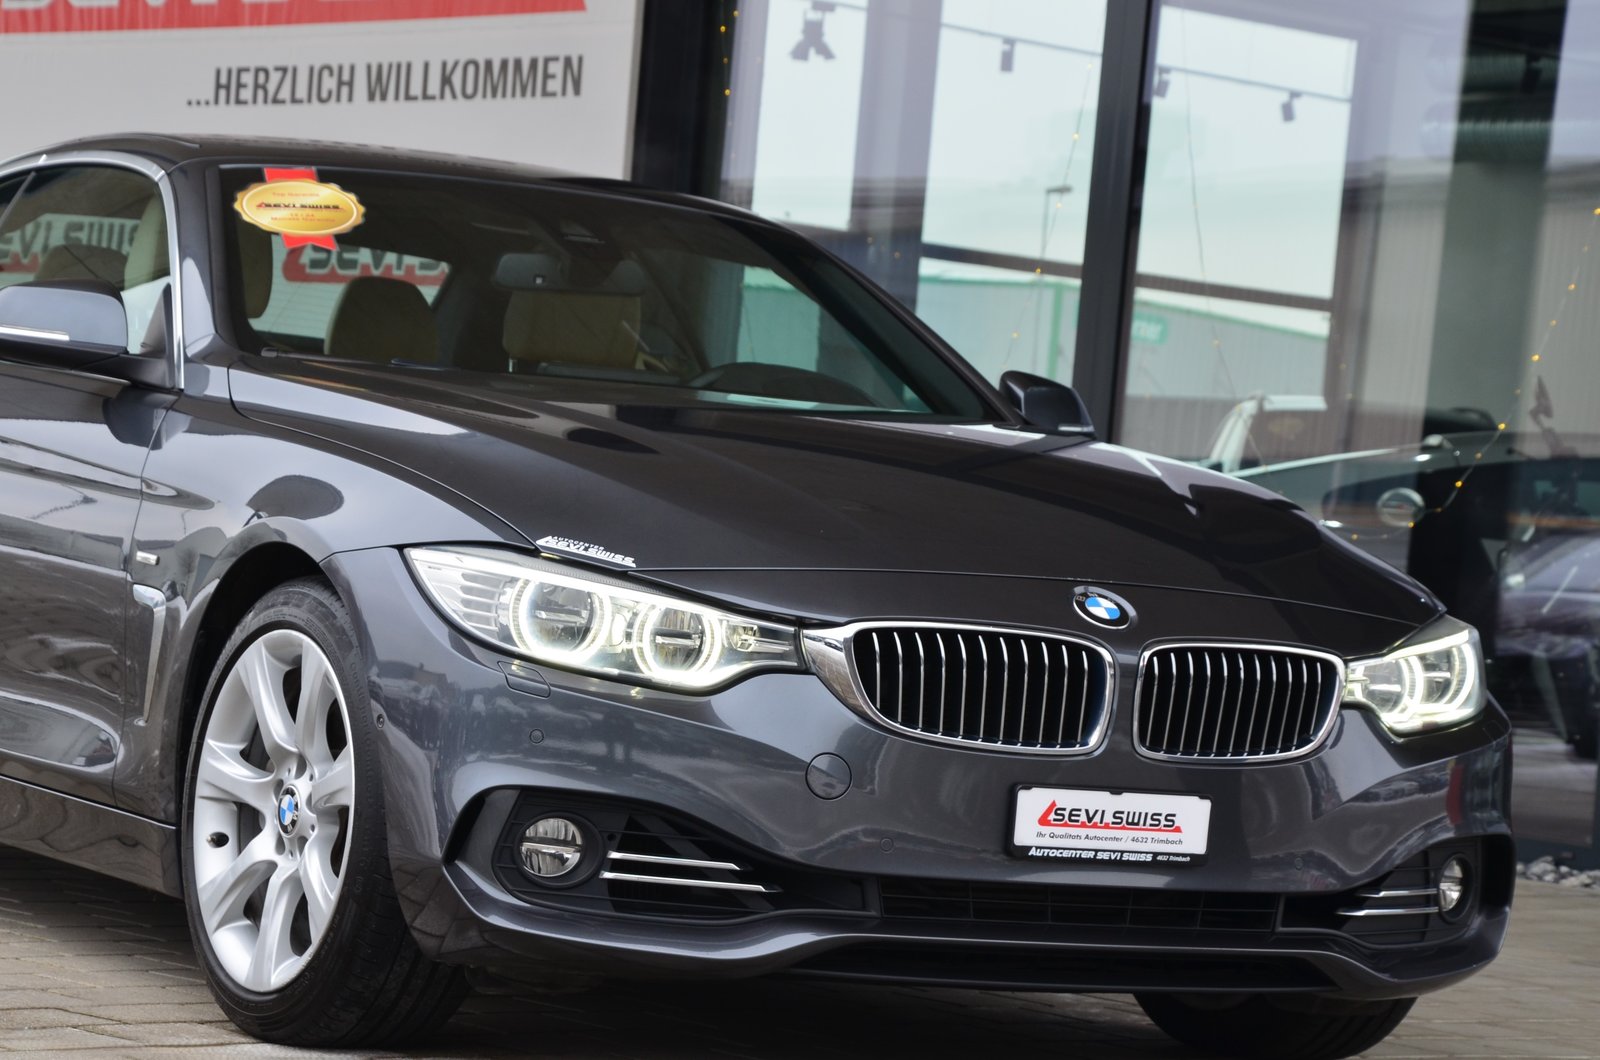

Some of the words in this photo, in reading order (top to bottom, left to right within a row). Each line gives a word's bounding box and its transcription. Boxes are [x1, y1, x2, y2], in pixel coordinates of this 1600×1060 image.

[366, 55, 584, 102] WILLKOMMEN
[587, 547, 636, 565] SWISS
[1052, 807, 1106, 825] SEVI
[1111, 810, 1177, 828] SWISS
[1084, 834, 1123, 842] Autocenter
[1131, 836, 1149, 844] 4632
[1150, 837, 1183, 846] Trimbach
[1028, 847, 1095, 859] AUTOCENTER
[1096, 851, 1121, 860] SEVI
[1122, 852, 1153, 861] SWISS
